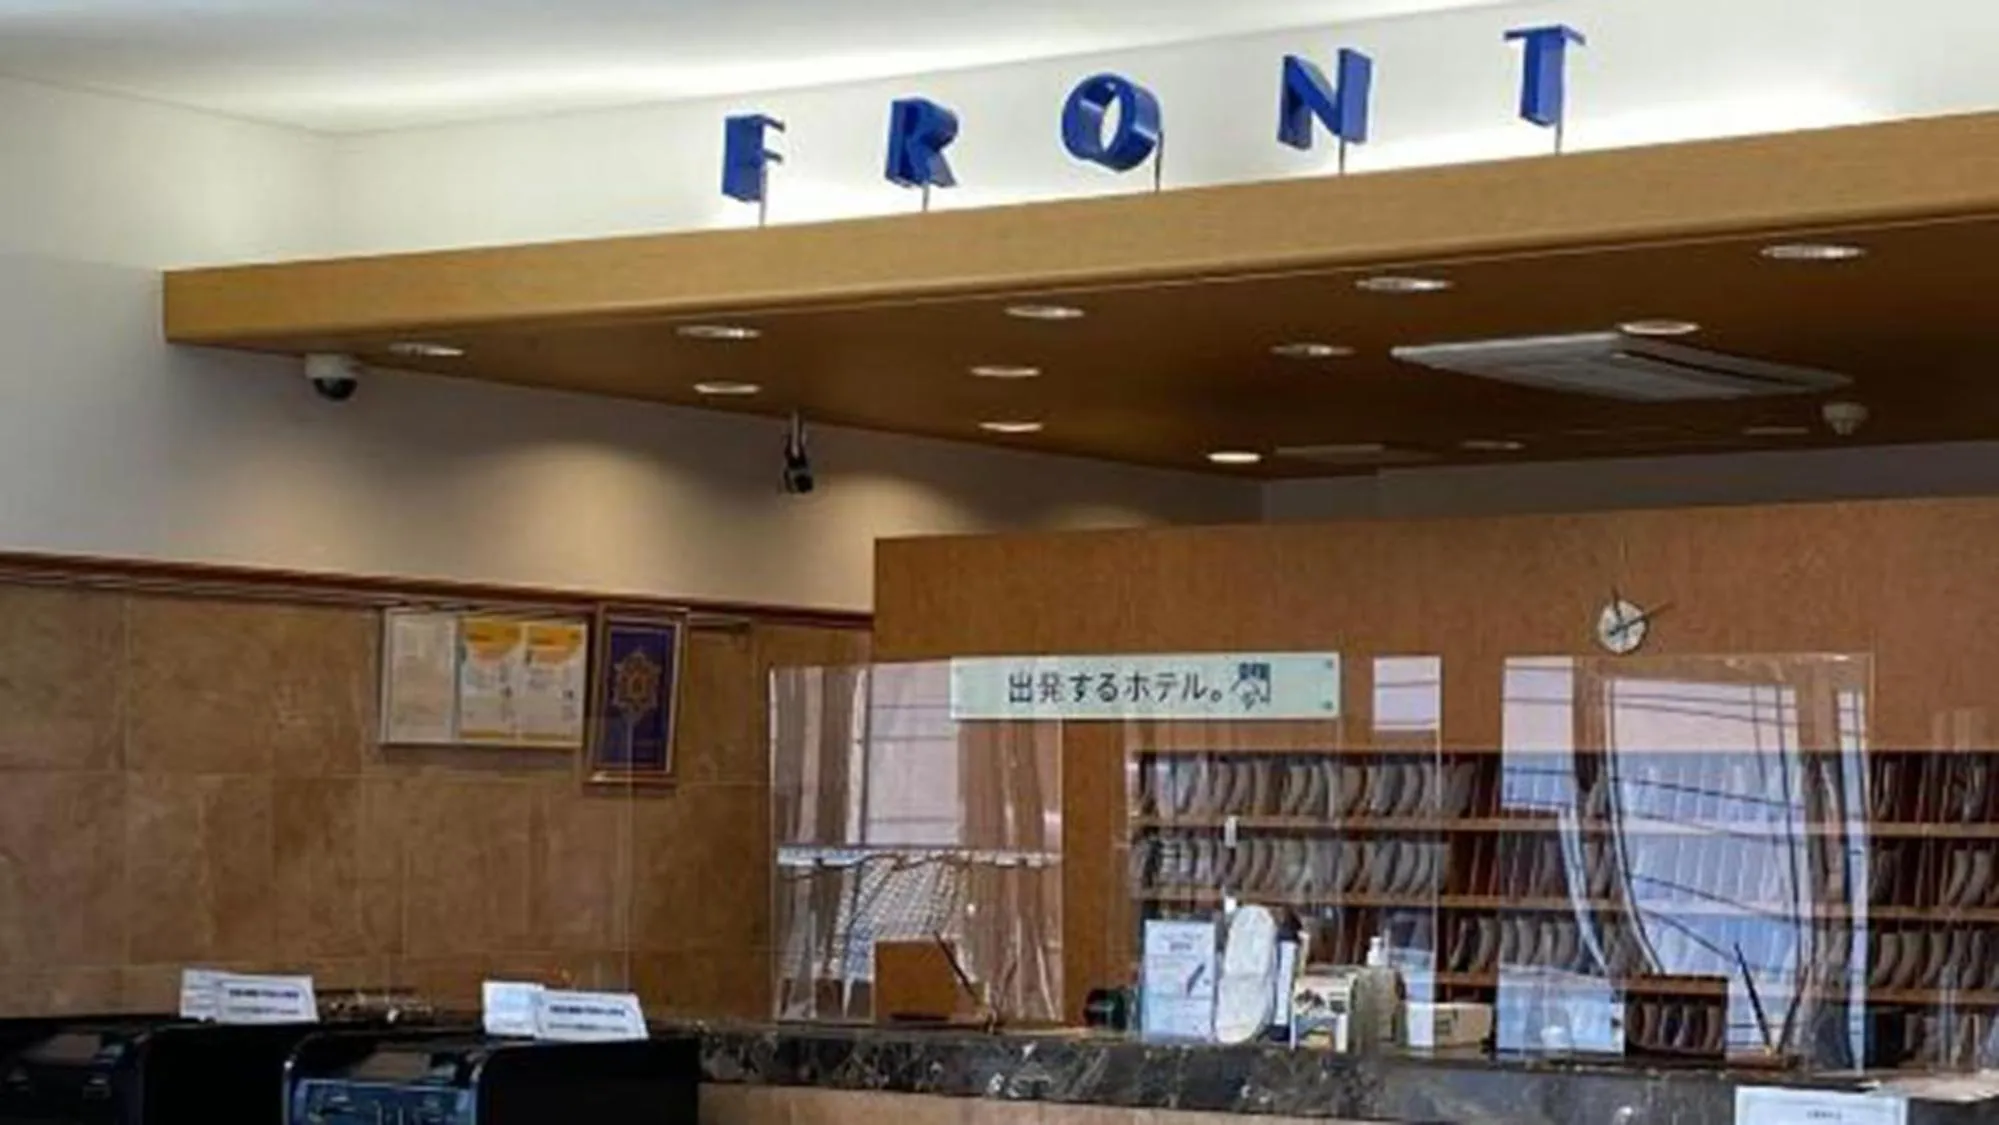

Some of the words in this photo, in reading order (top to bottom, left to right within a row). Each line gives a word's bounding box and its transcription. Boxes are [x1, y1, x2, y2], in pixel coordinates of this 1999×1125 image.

[722, 24, 1585, 202] FRONT
[1008, 670, 1223, 704] 出発するホテル。
